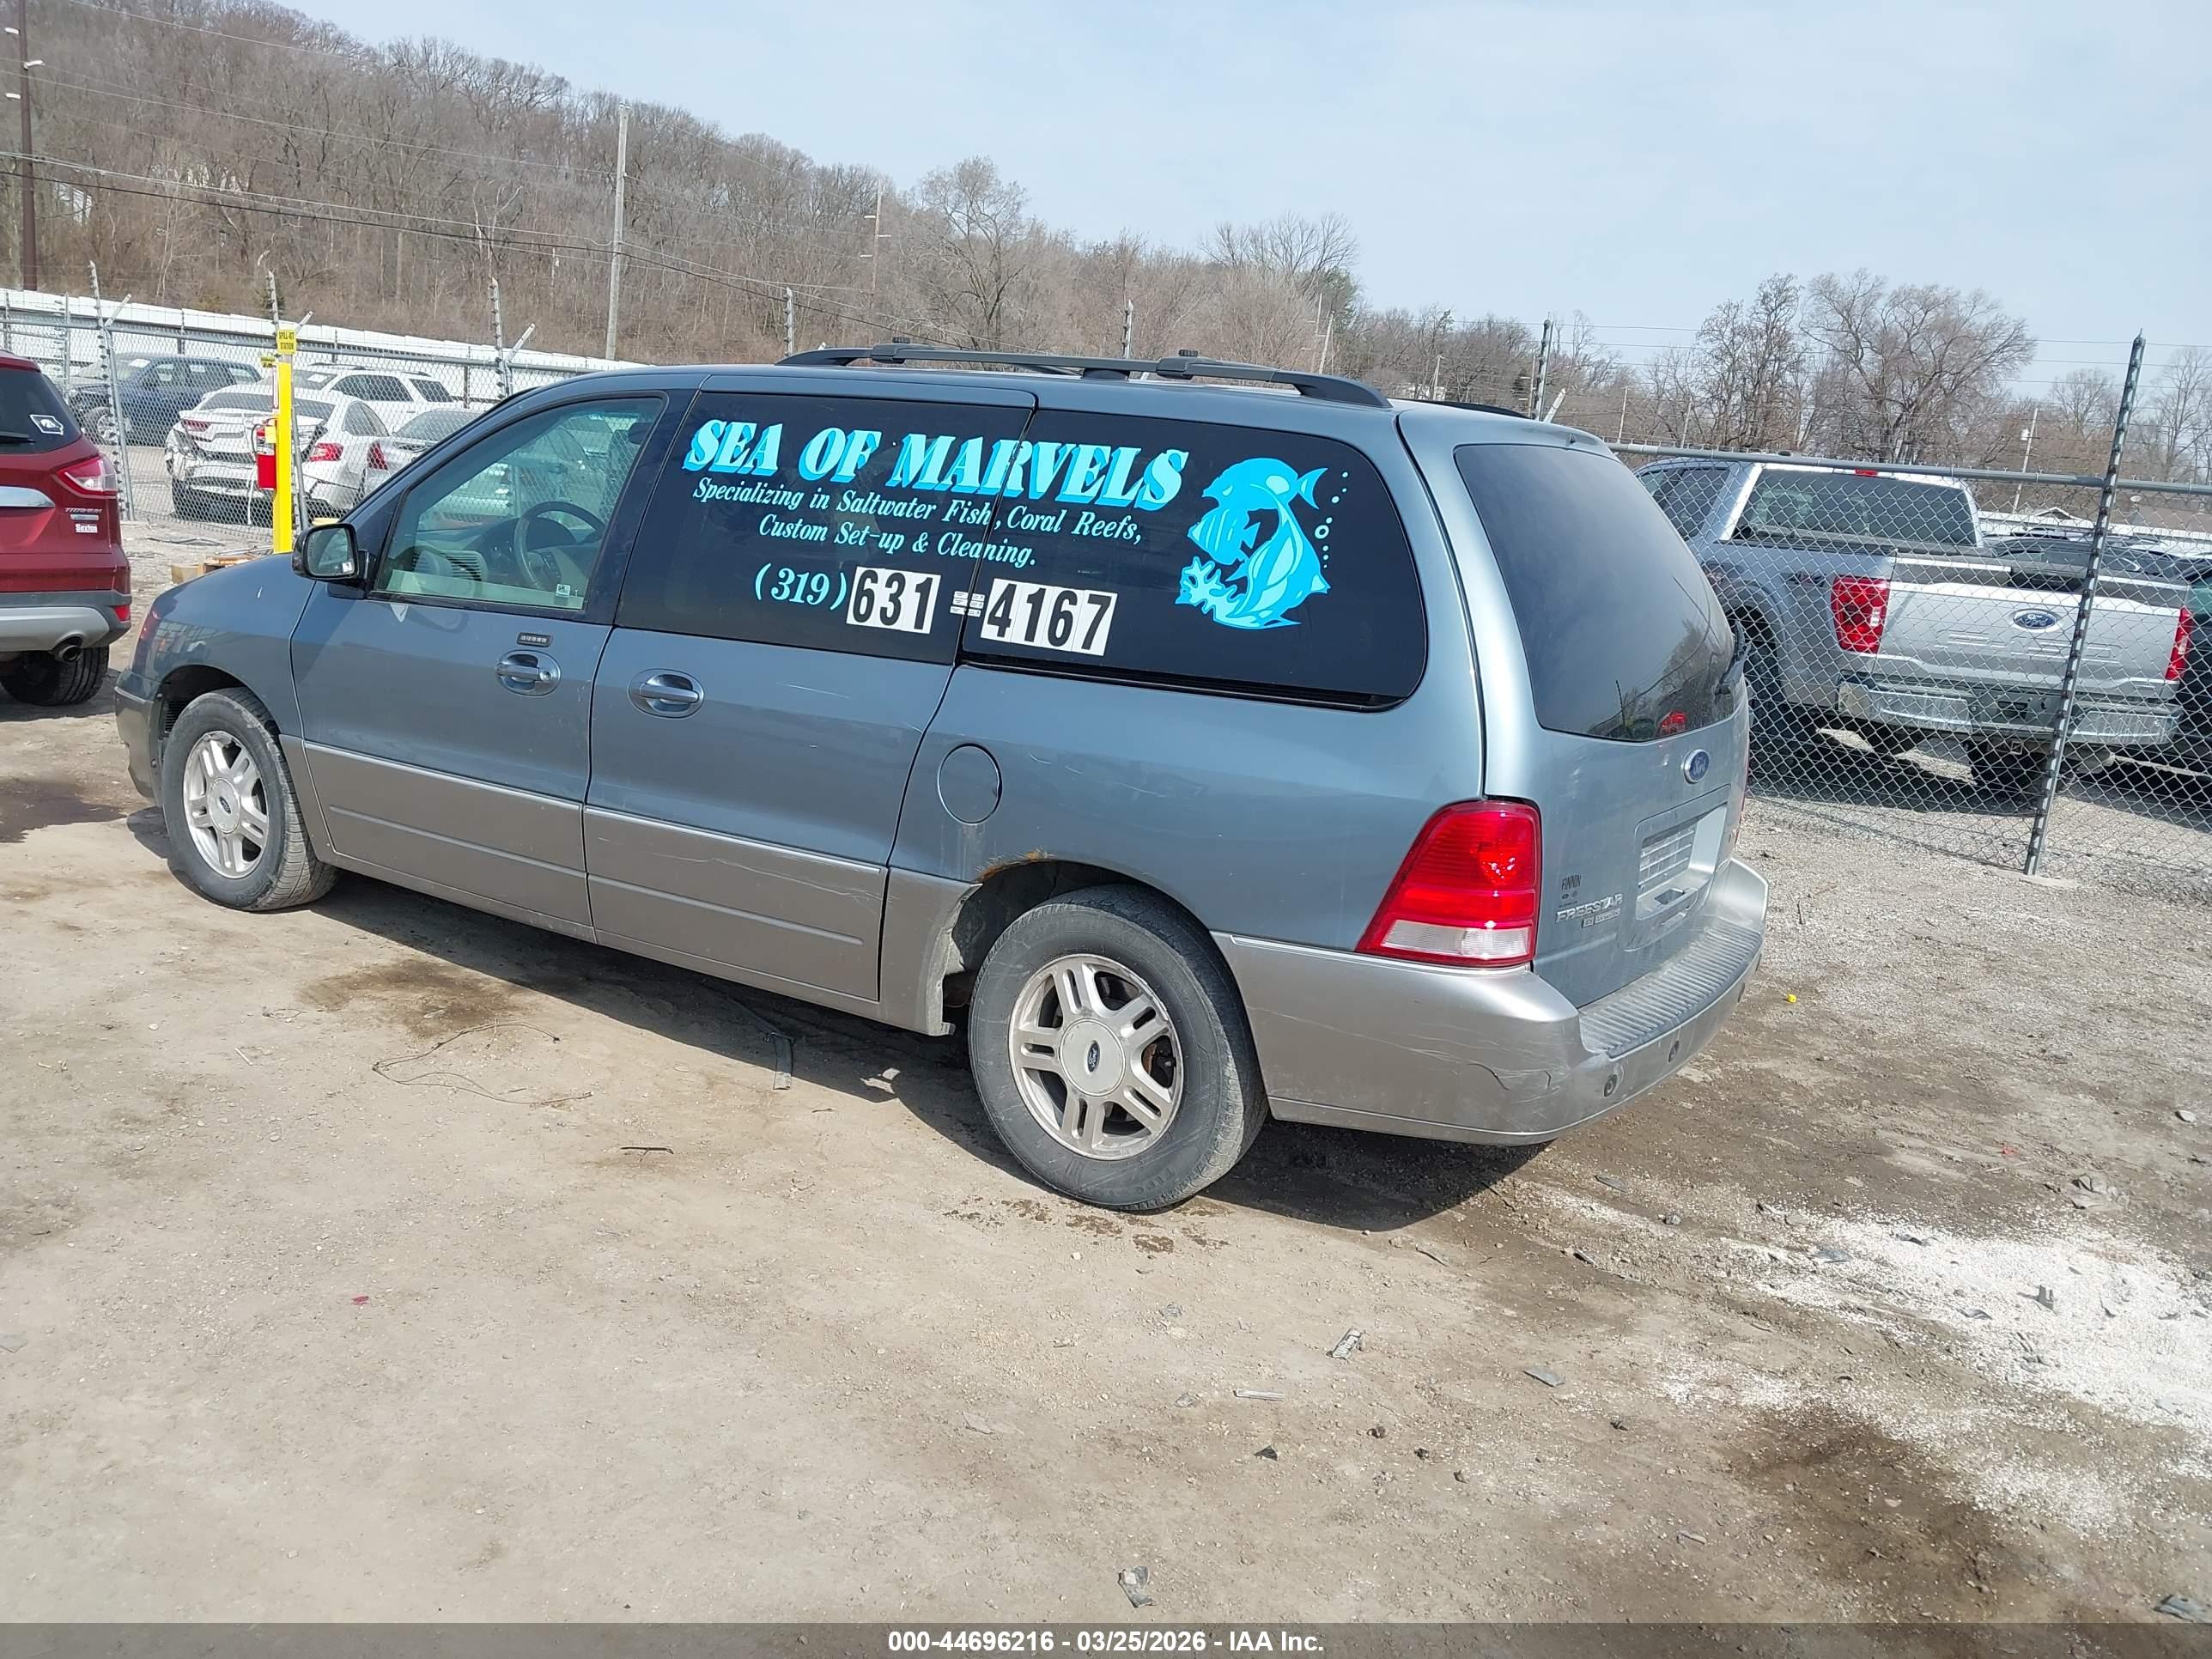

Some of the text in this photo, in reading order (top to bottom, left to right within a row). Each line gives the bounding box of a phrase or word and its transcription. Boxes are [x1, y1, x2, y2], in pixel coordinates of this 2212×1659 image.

[682, 419, 1189, 511] SEA OF MARVELS
[692, 477, 804, 511] Specializing
[809, 488, 830, 510] in
[836, 489, 937, 521] Saltwater
[1006, 505, 1067, 533] Coral
[1071, 511, 1142, 545] Reefs,
[759, 514, 1036, 568] Custom Set-up & Cleaning.
[1555, 894, 1623, 923] FREESTAR
